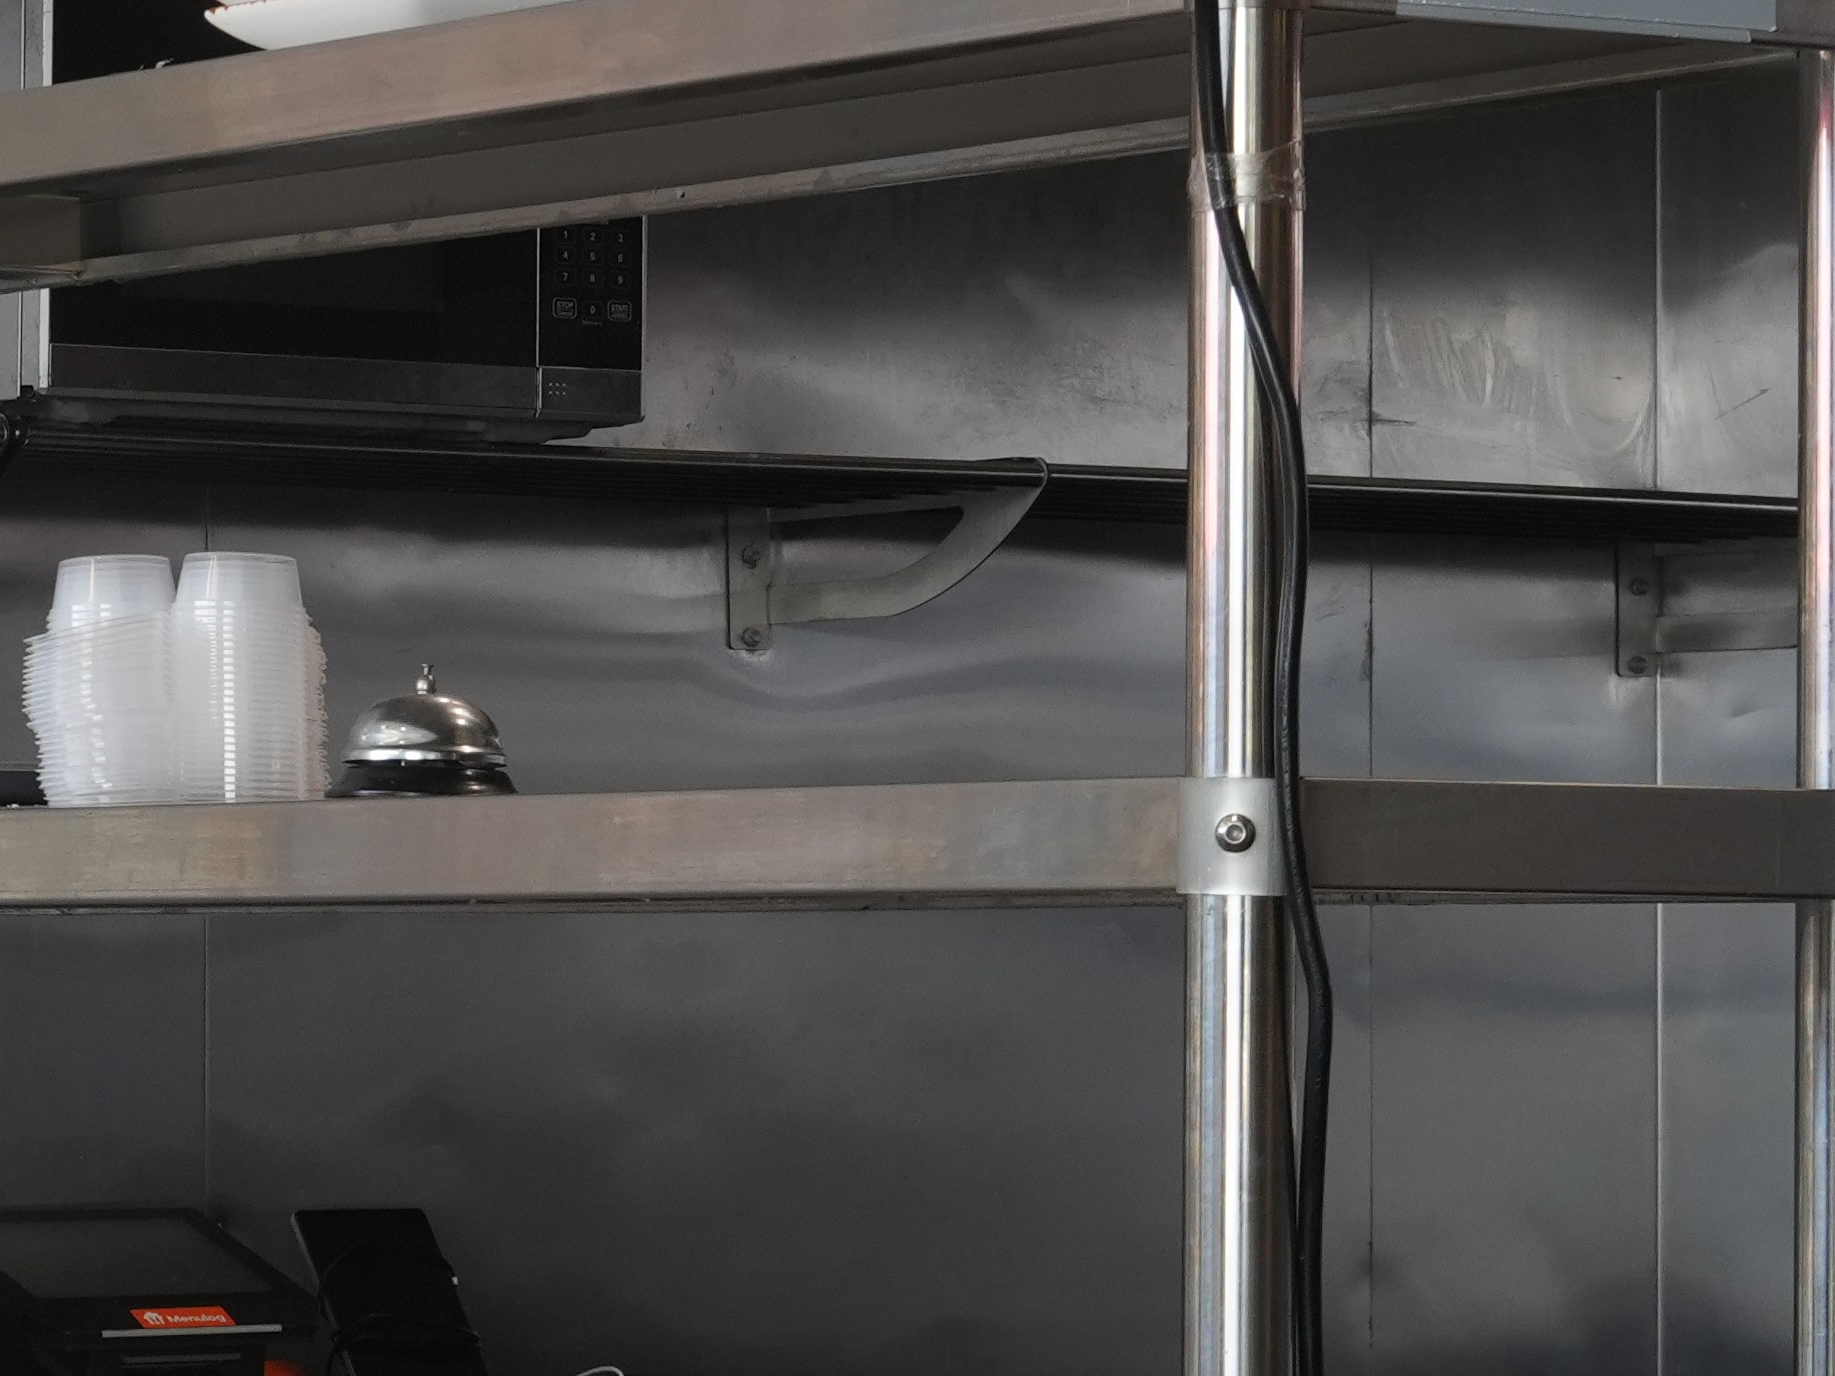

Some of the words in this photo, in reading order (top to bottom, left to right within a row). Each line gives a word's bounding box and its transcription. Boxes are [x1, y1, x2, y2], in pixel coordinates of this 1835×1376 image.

[564, 230, 568, 239] 1
[590, 232, 595, 241] 2
[563, 251, 568, 260] 4
[590, 252, 595, 261] 5
[618, 254, 623, 262] 6
[563, 272, 568, 281] 7
[618, 275, 623, 285] 9
[165, 1314, 227, 1323] Menulog
